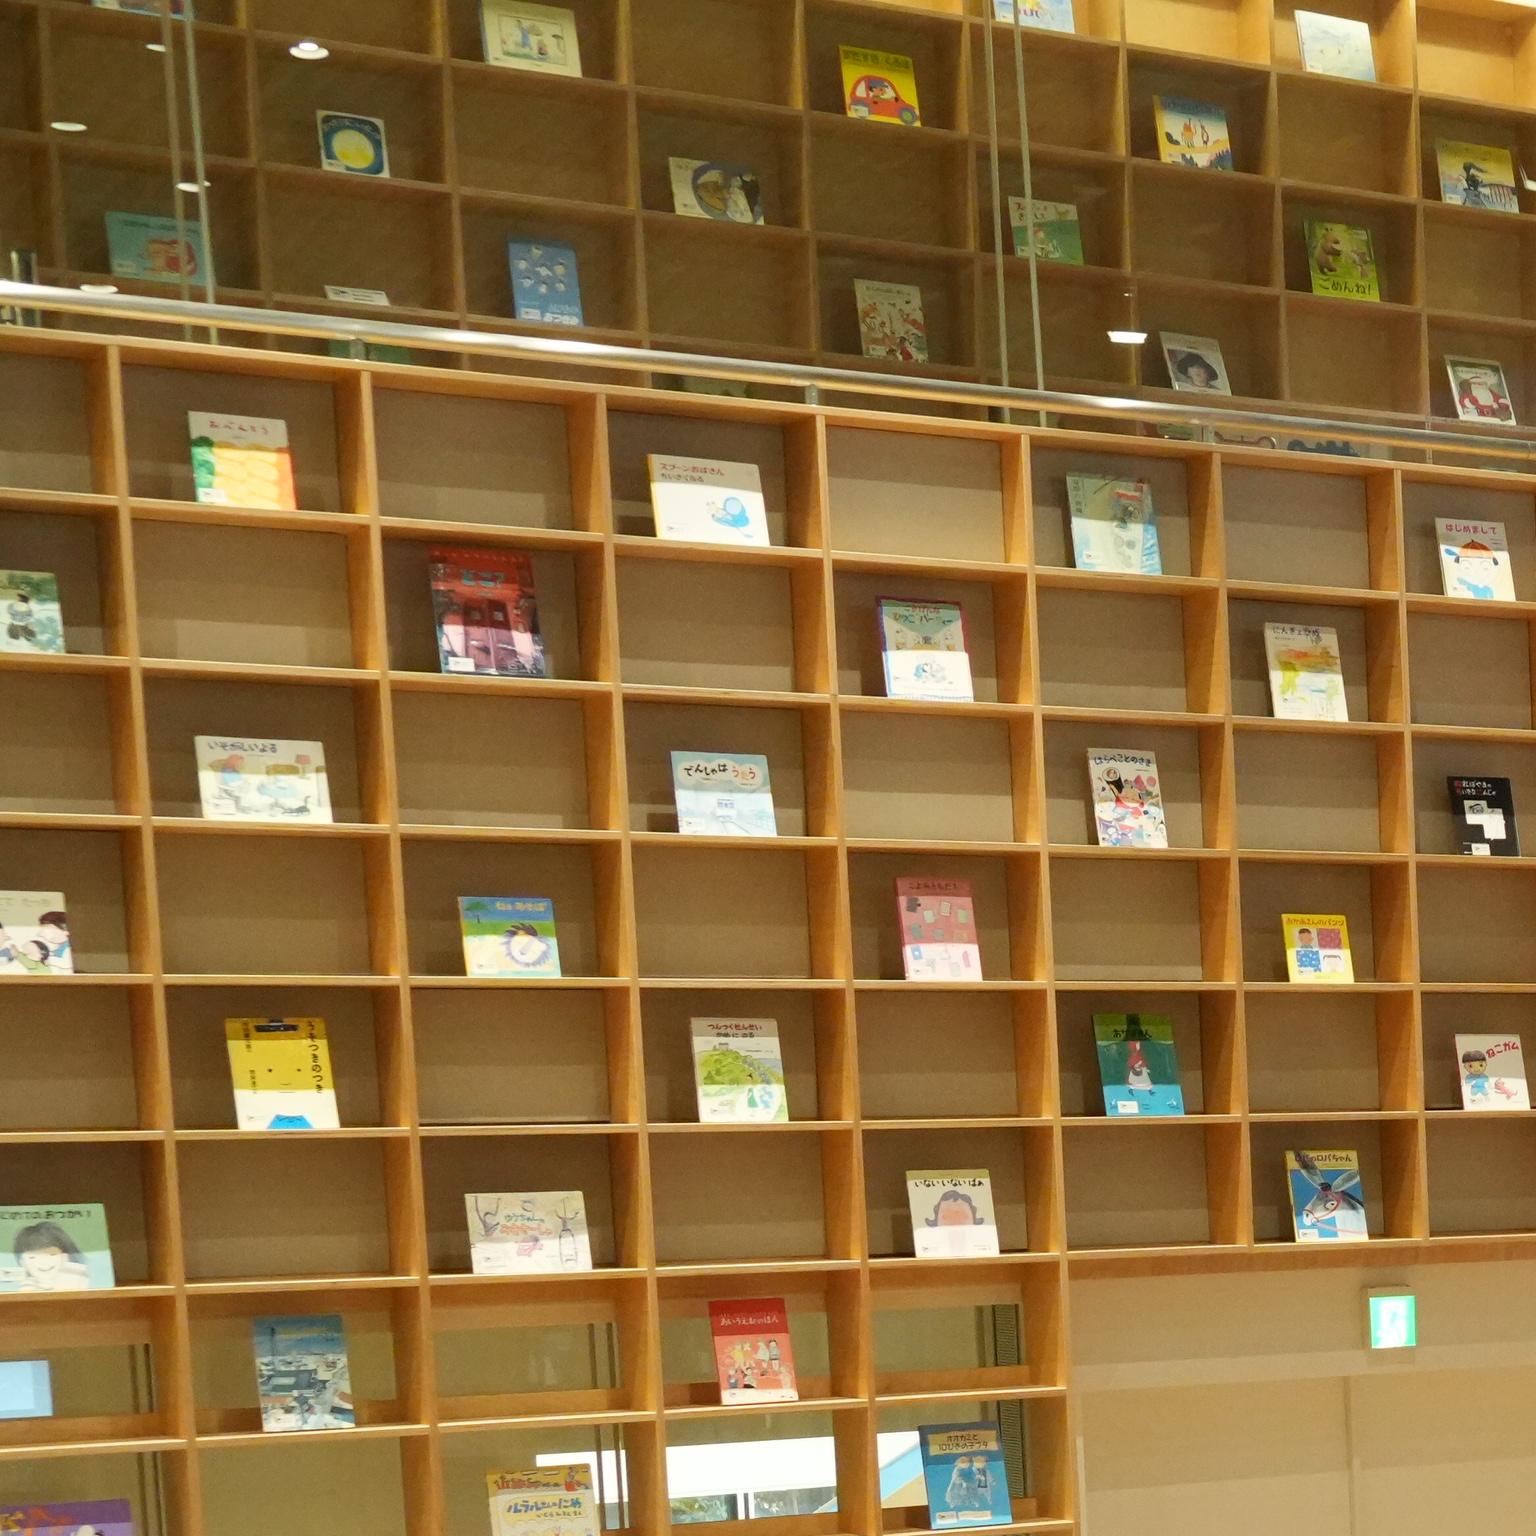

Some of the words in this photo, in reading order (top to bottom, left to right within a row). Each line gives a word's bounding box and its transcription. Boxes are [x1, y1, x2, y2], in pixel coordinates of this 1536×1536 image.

[1446, 523, 1497, 535] はじめまして
[308, 1019, 325, 1095] うそつきのつき
